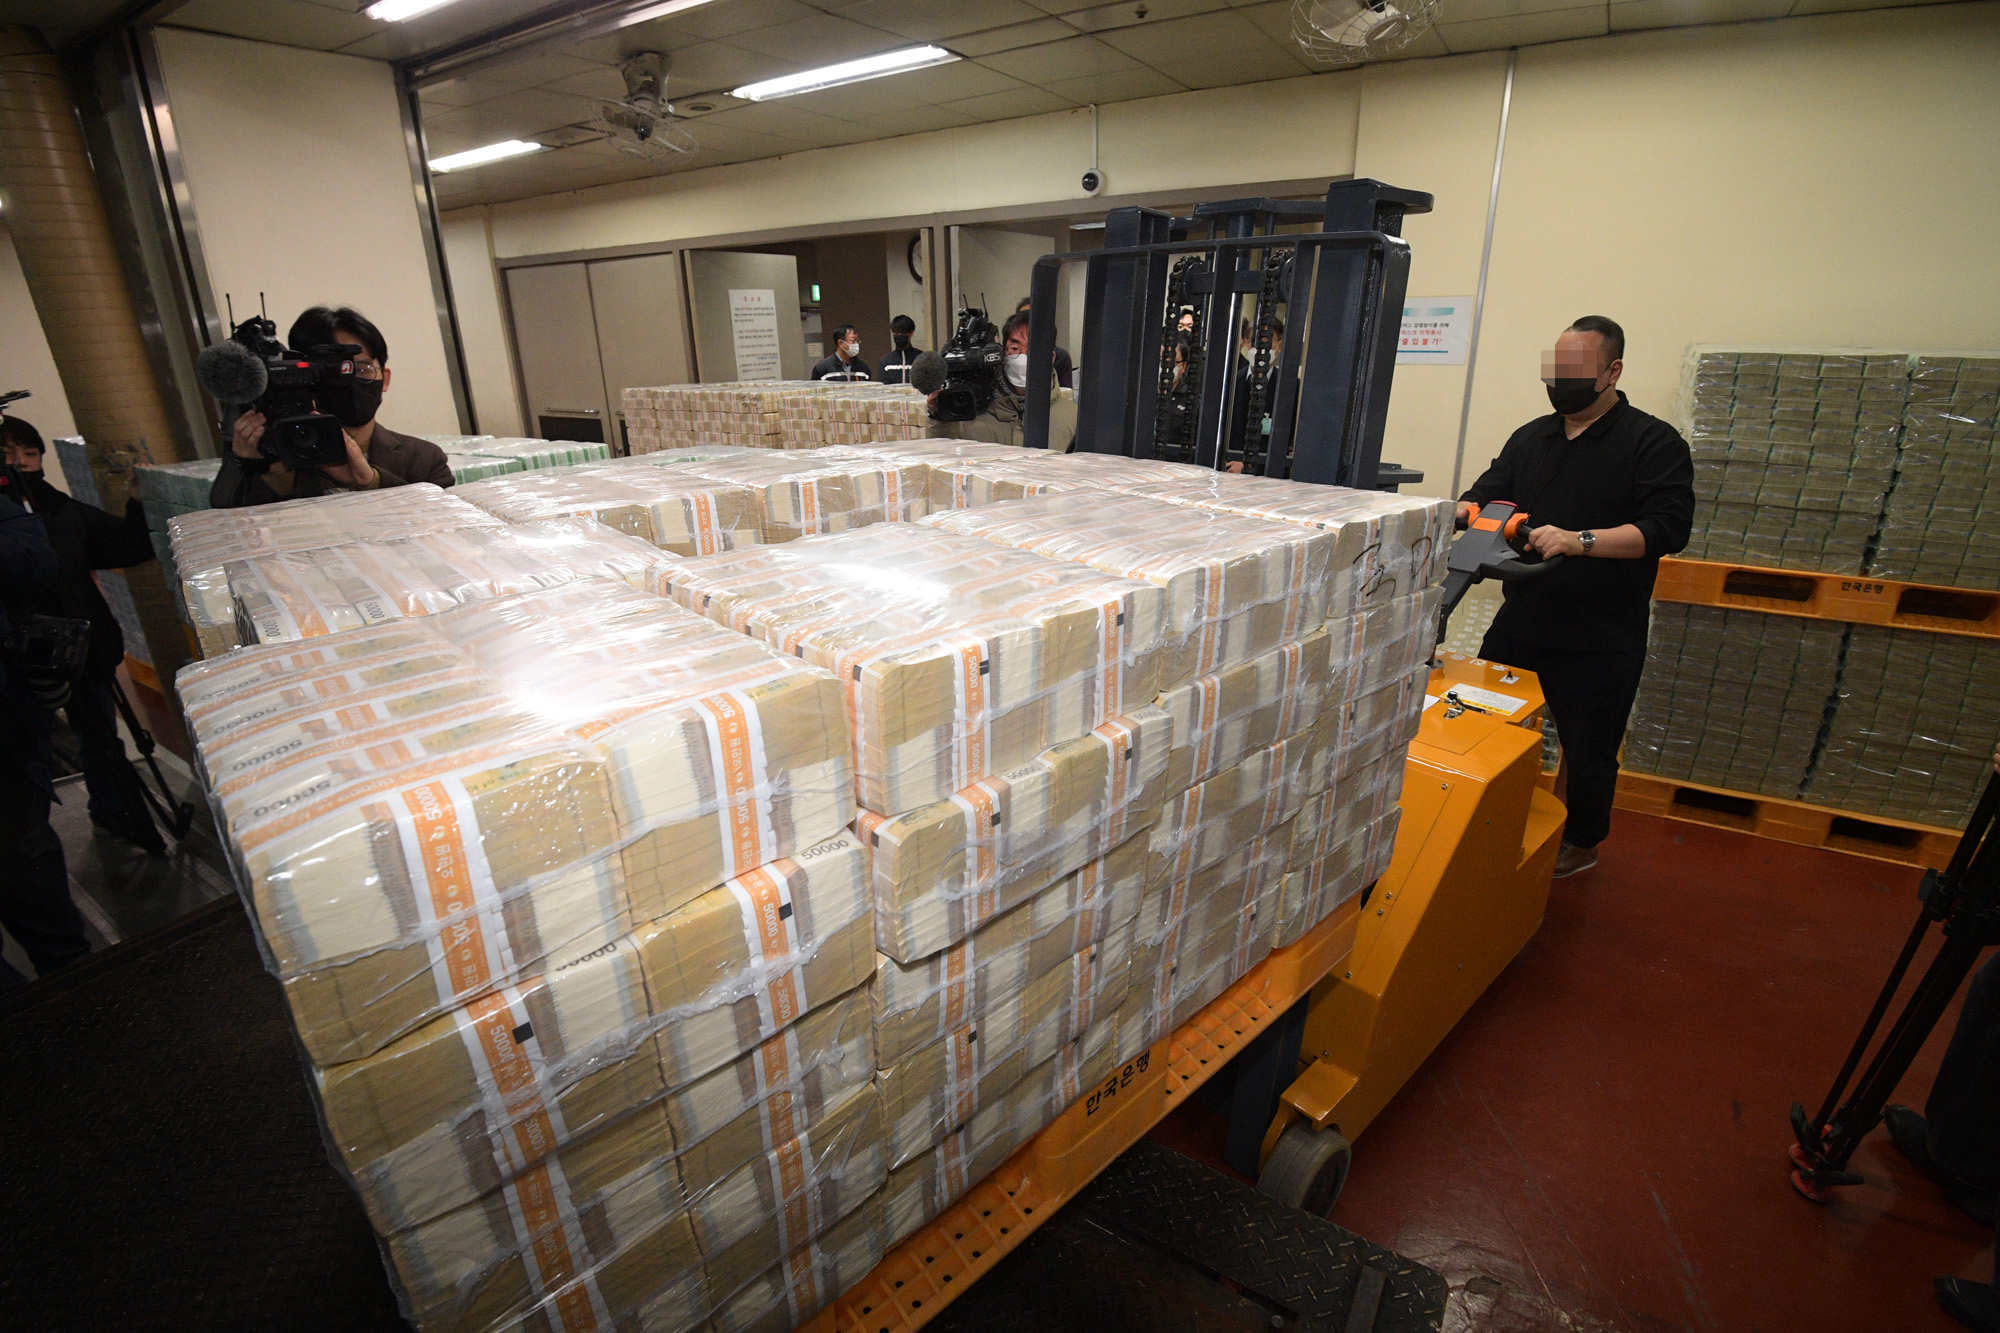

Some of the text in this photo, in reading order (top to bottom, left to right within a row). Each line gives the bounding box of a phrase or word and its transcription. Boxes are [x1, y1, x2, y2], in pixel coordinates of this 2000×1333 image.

[983, 352, 1001, 362] KBS
[1841, 582, 1885, 595] 한국은행
[362, 600, 385, 620] 50000
[1108, 608, 1117, 638] 50000
[968, 655, 979, 689] 50000
[1107, 686, 1115, 714] 50000
[232, 738, 303, 773] 50000
[729, 737, 745, 771] 오만원
[971, 742, 981, 773] 50000
[253, 778, 332, 818] 50000
[414, 786, 455, 880] 오만원 50000
[801, 838, 850, 860] 50000
[741, 841, 753, 867] 오만원
[763, 901, 778, 938] 50000
[461, 964, 480, 989] 만원
[776, 987, 792, 1020] 50000
[489, 1023, 516, 1064] 50000
[1086, 1049, 1151, 1117] 한국은행
[524, 1116, 547, 1151] 50000
